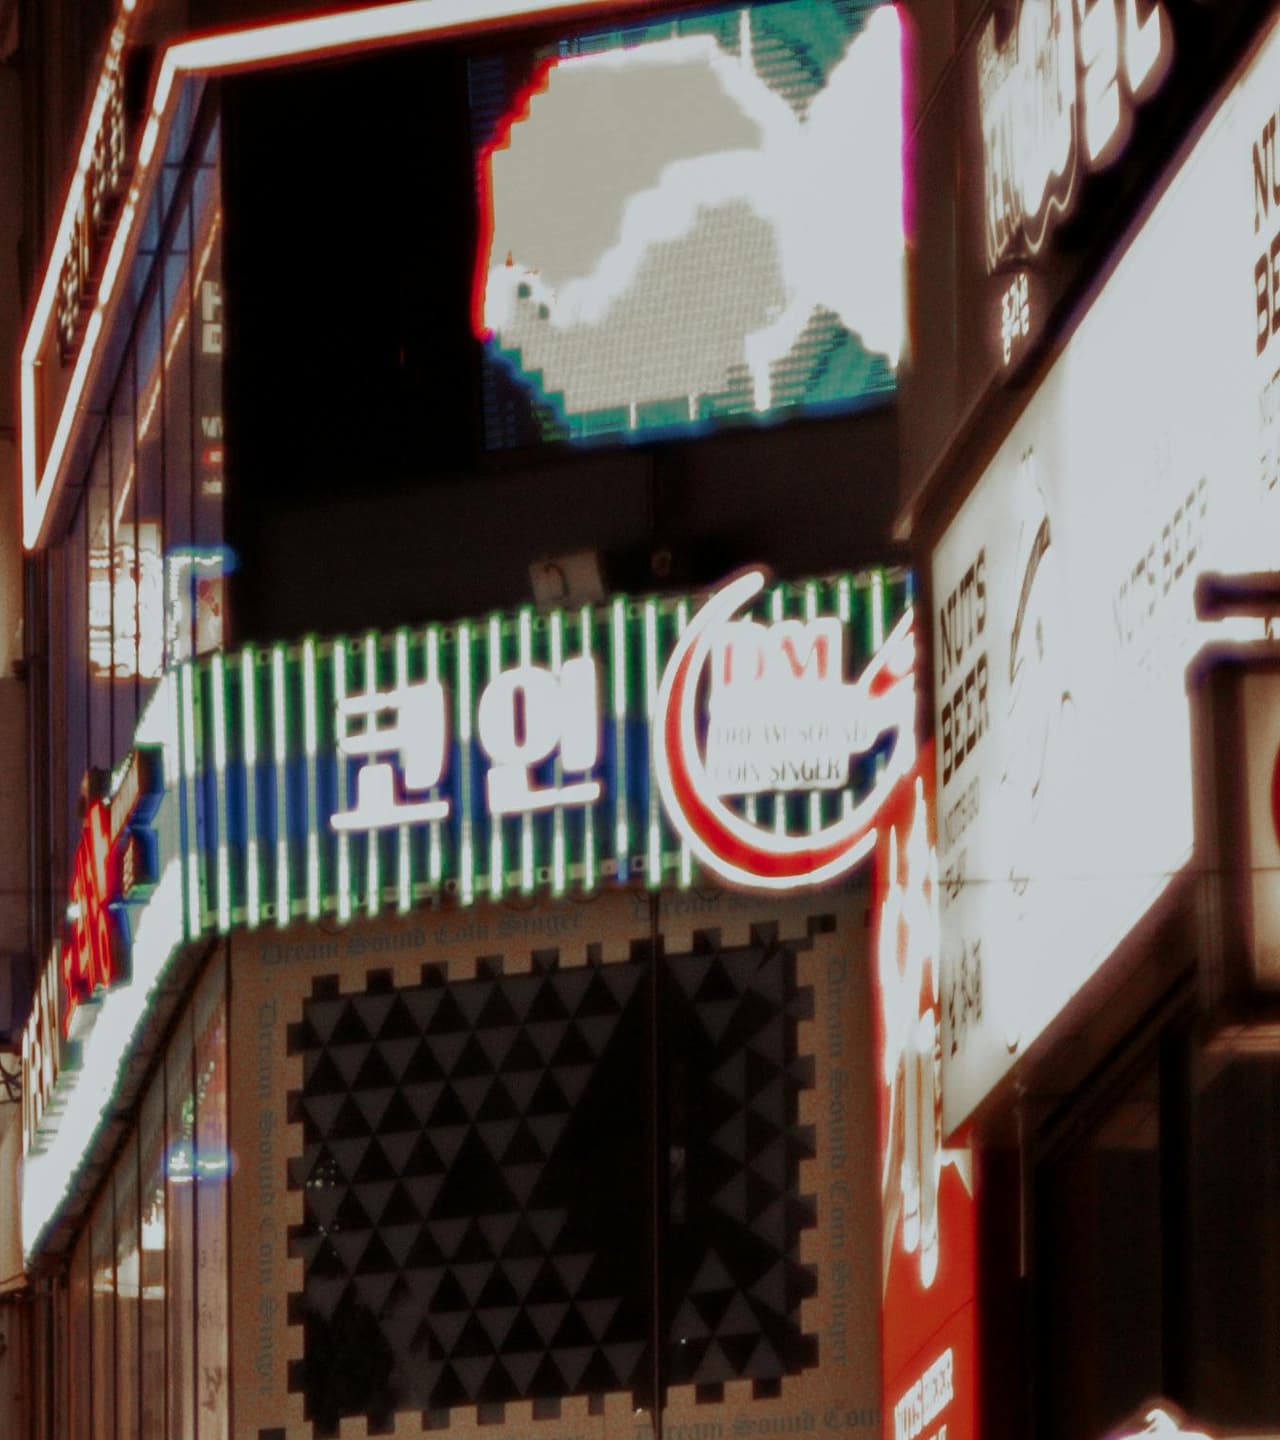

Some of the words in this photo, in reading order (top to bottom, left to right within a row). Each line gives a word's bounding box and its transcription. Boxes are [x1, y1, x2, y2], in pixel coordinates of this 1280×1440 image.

[940, 544, 988, 688] NUTS
[330, 655, 602, 830] 코인
[941, 650, 989, 788] BEER
